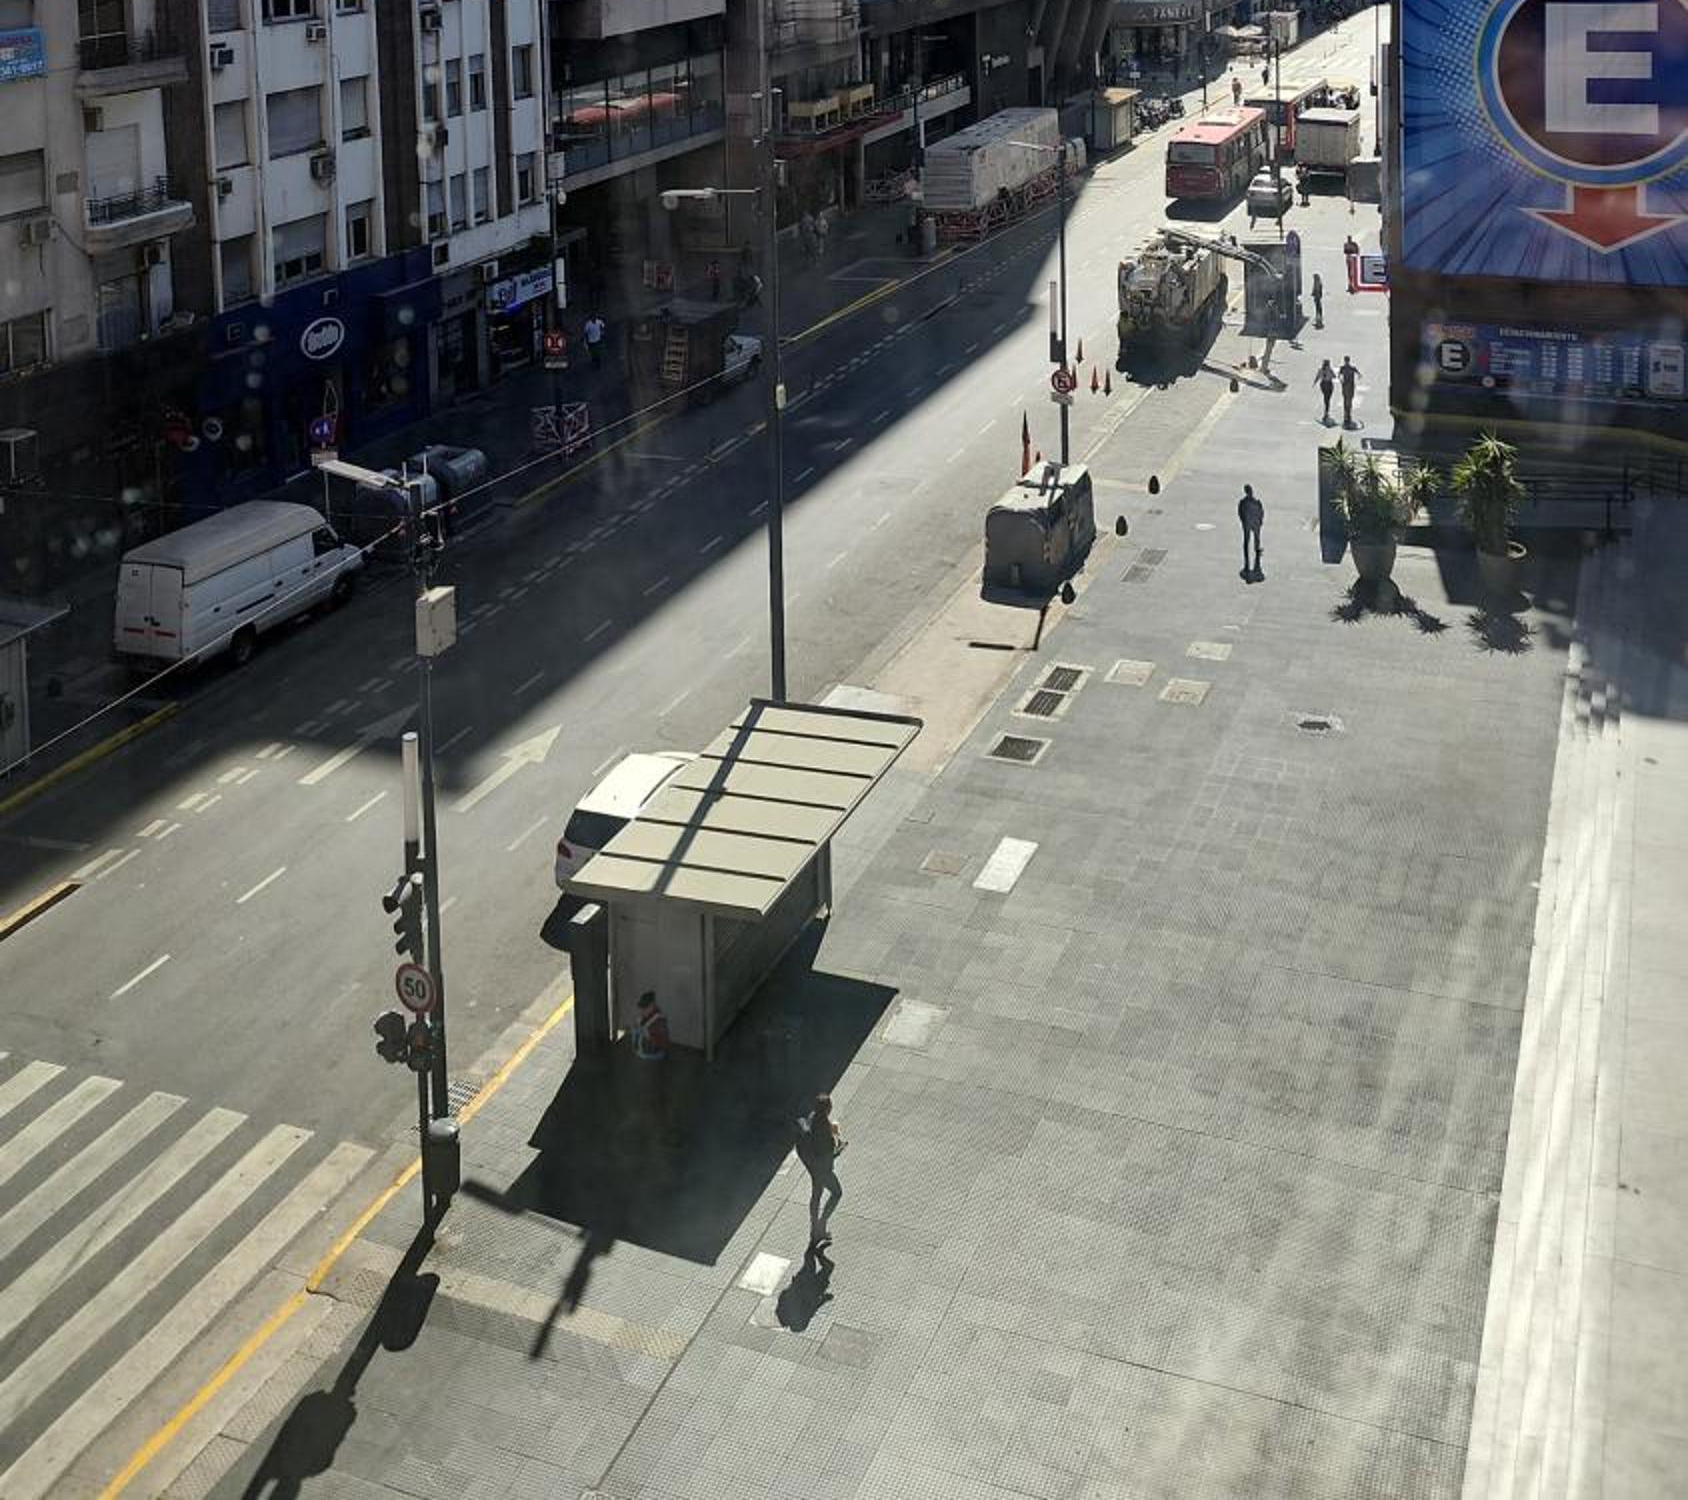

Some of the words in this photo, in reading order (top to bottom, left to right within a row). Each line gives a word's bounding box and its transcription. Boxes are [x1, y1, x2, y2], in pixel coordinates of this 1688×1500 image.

[1545, 3, 1658, 134] E
[1363, 257, 1386, 283] E
[1441, 343, 1464, 369] E
[404, 977, 426, 997] 50
